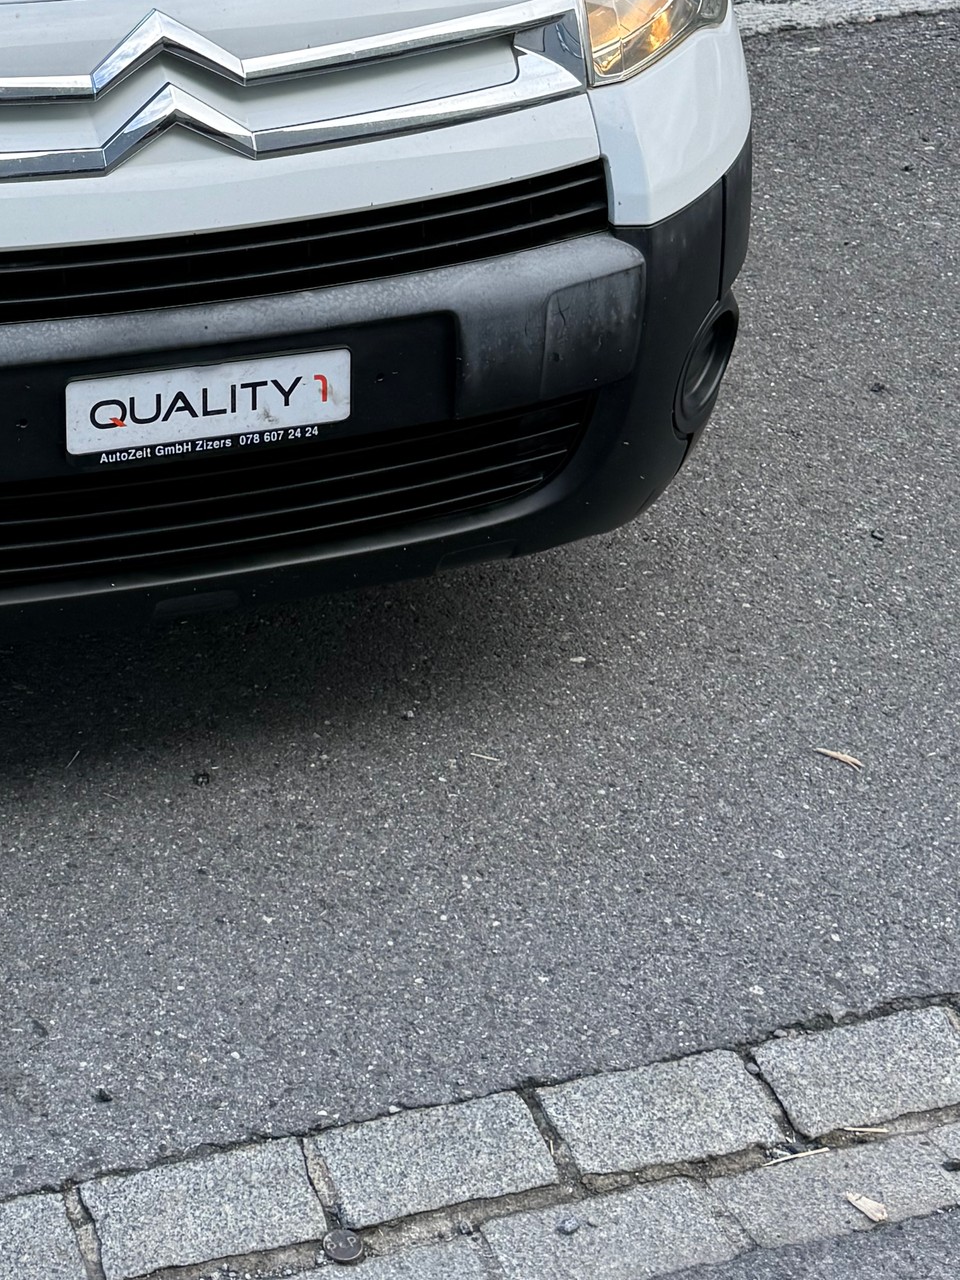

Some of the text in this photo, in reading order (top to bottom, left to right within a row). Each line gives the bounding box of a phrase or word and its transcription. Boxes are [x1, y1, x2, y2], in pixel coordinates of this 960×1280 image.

[90, 374, 328, 430] QUALITY 1
[99, 426, 319, 464] AutoZeit GmbH Zizers 078 607 24 24
